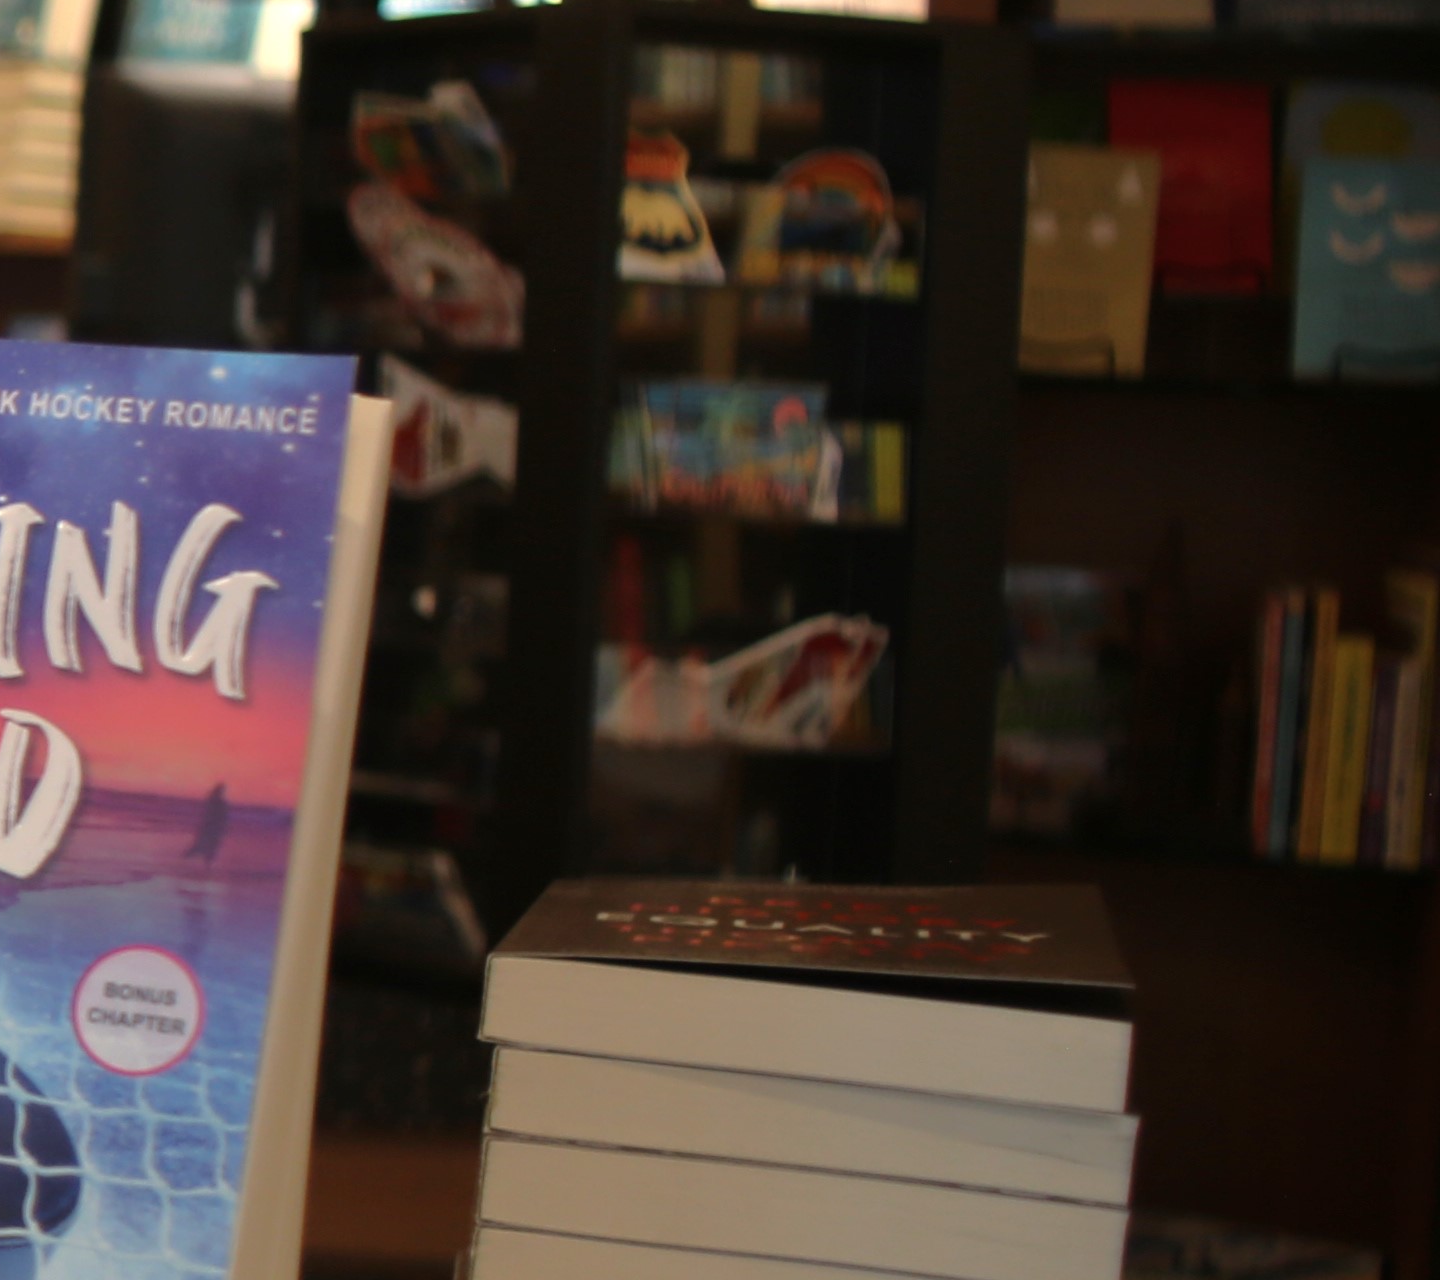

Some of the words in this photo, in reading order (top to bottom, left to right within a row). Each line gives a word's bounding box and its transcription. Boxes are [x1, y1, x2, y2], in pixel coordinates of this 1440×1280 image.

[28, 390, 155, 425] HOCKEY
[163, 399, 319, 436] ROMANCE
[596, 910, 1051, 943] EQUALITY
[104, 981, 177, 1007] BONUS
[87, 1006, 186, 1036] CHAPTER
